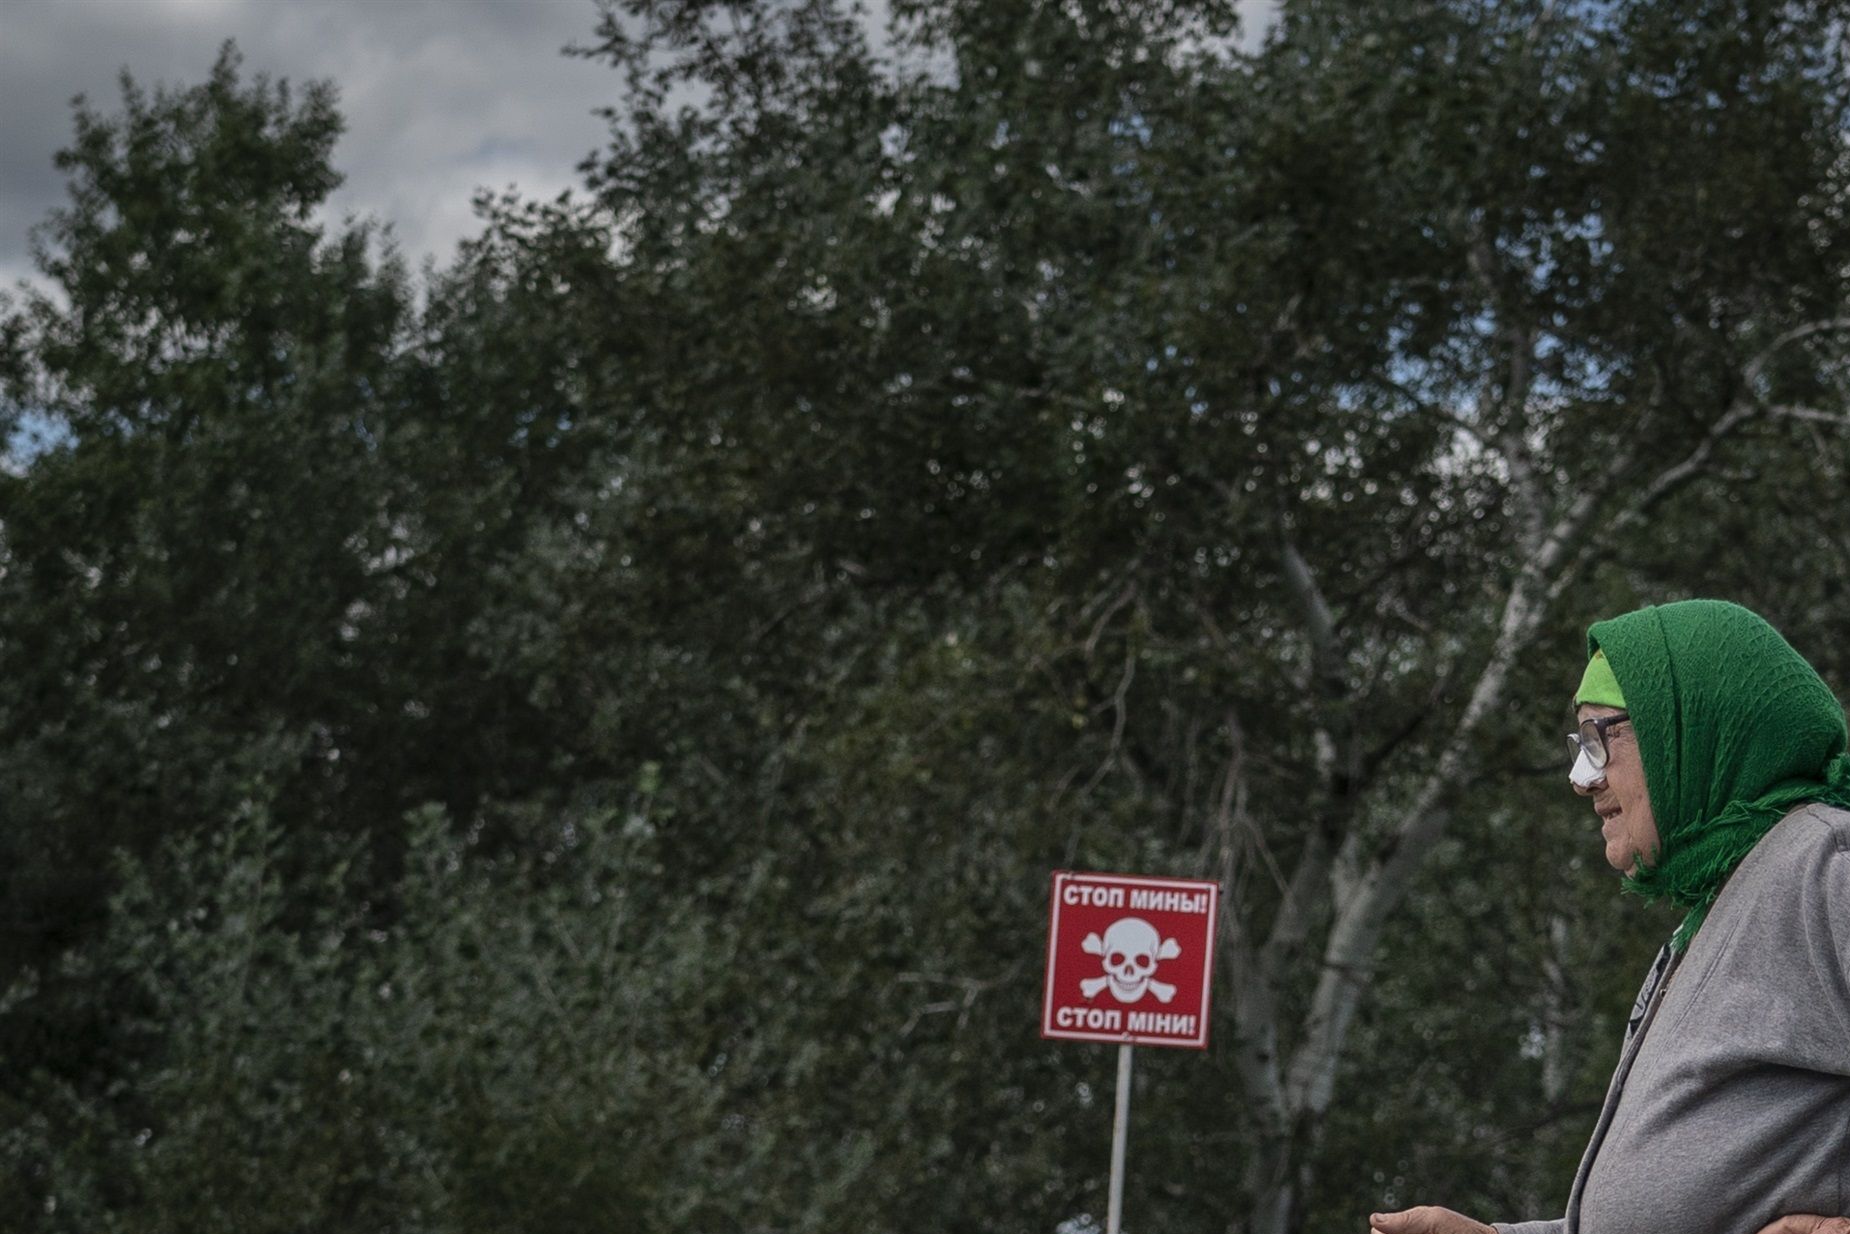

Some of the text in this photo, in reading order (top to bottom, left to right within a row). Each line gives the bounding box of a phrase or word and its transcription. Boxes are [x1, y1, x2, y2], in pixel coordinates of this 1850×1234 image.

[1063, 885, 1208, 914] СТОП МИНЫ!
[1056, 1006, 1197, 1035] СТОП МІНИ!
